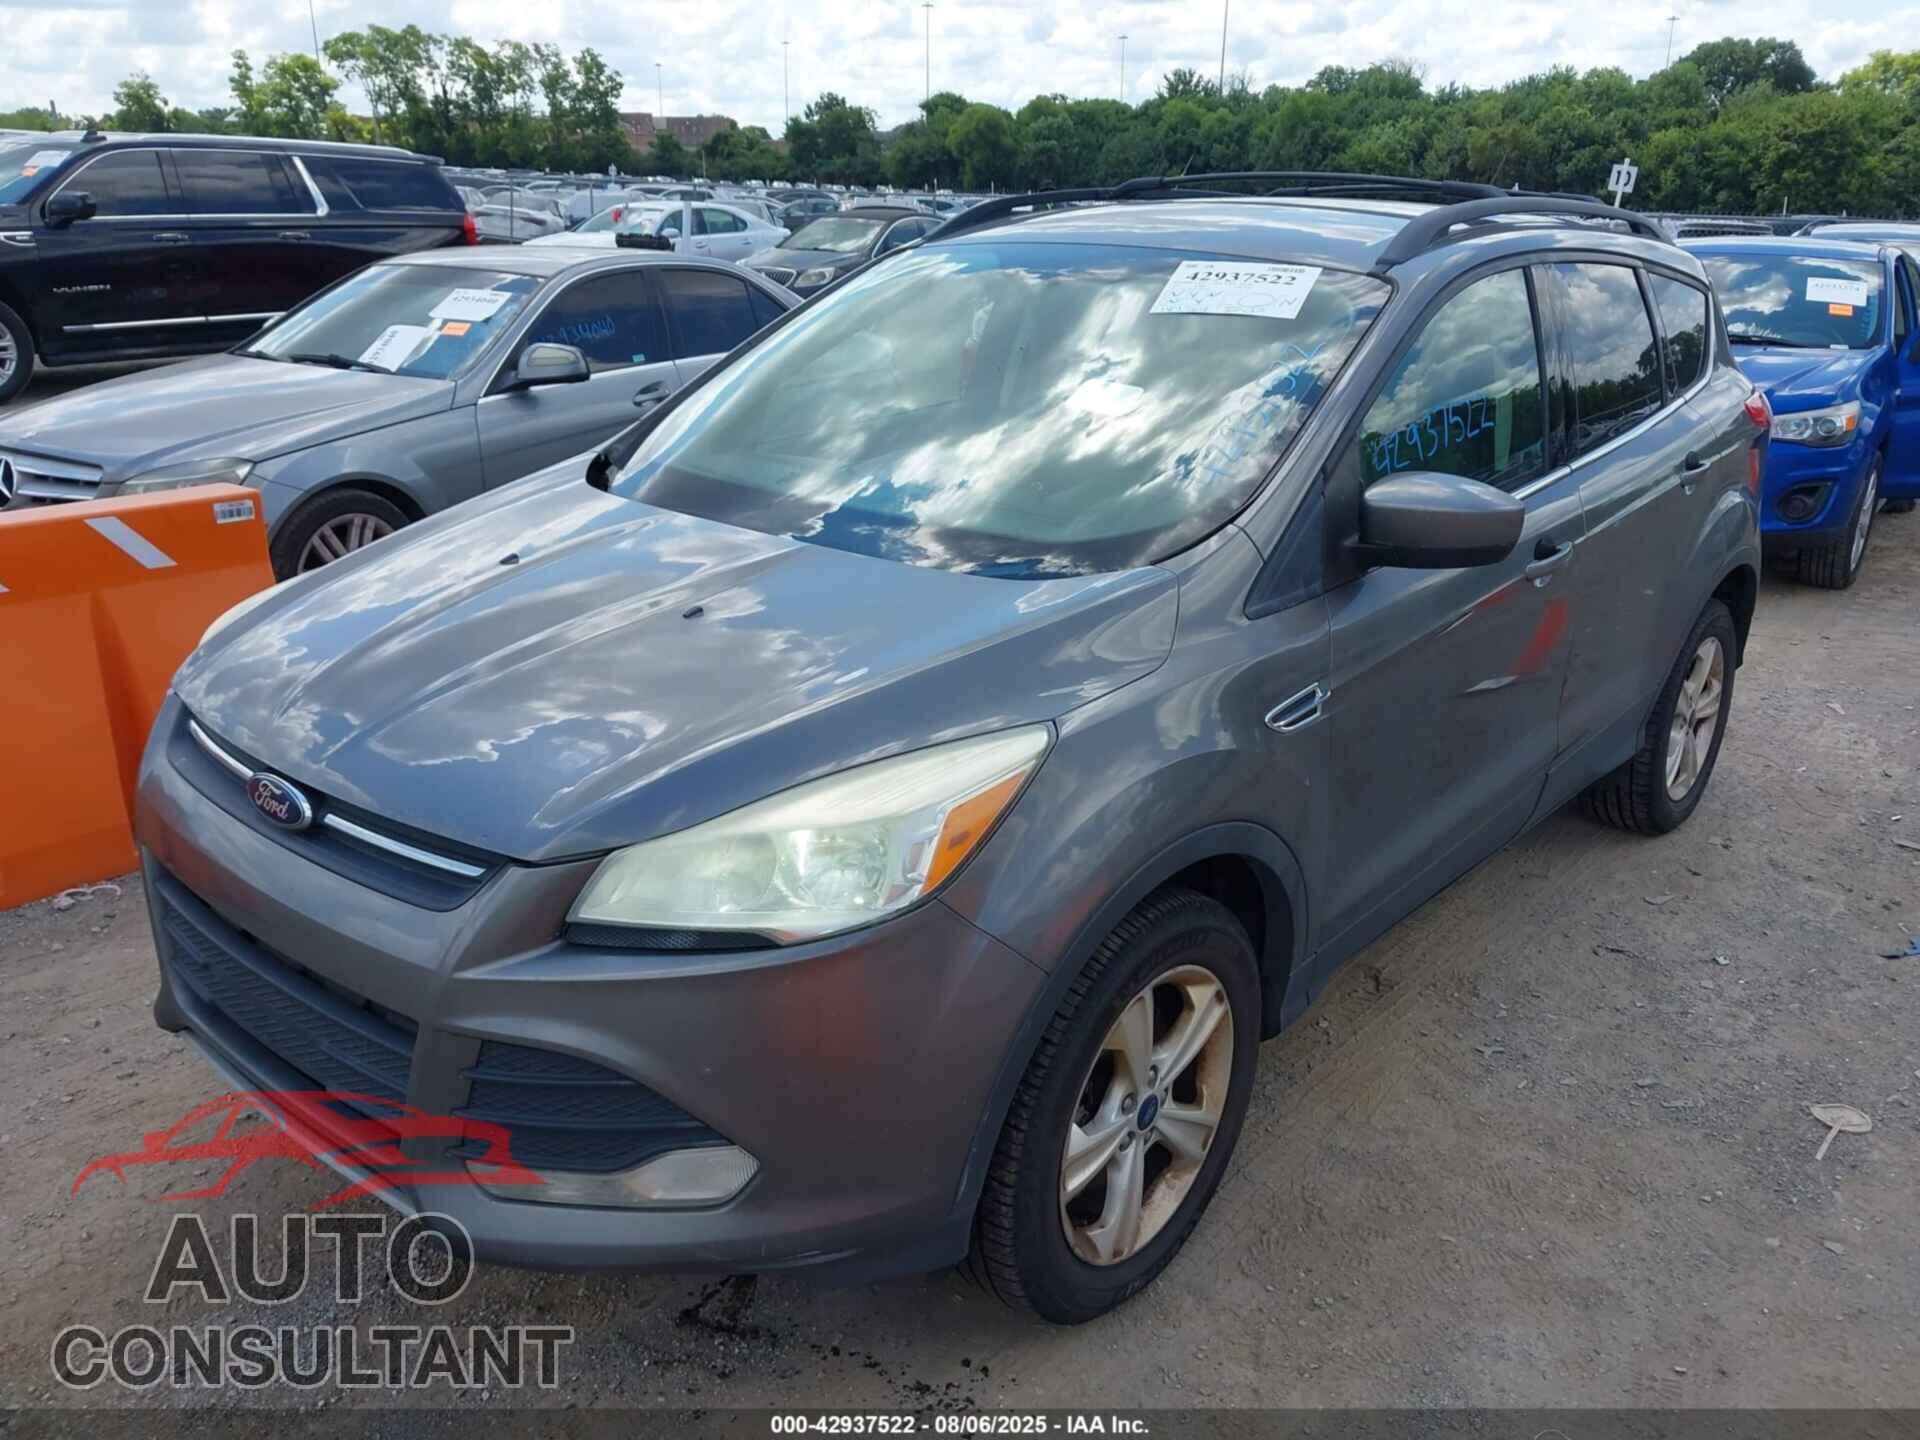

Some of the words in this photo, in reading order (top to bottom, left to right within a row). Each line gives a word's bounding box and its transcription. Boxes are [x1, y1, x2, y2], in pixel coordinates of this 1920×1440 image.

[1185, 271, 1297, 285] 42937522
[1372, 397, 1495, 474] 42937522
[255, 781, 289, 819] Ford
